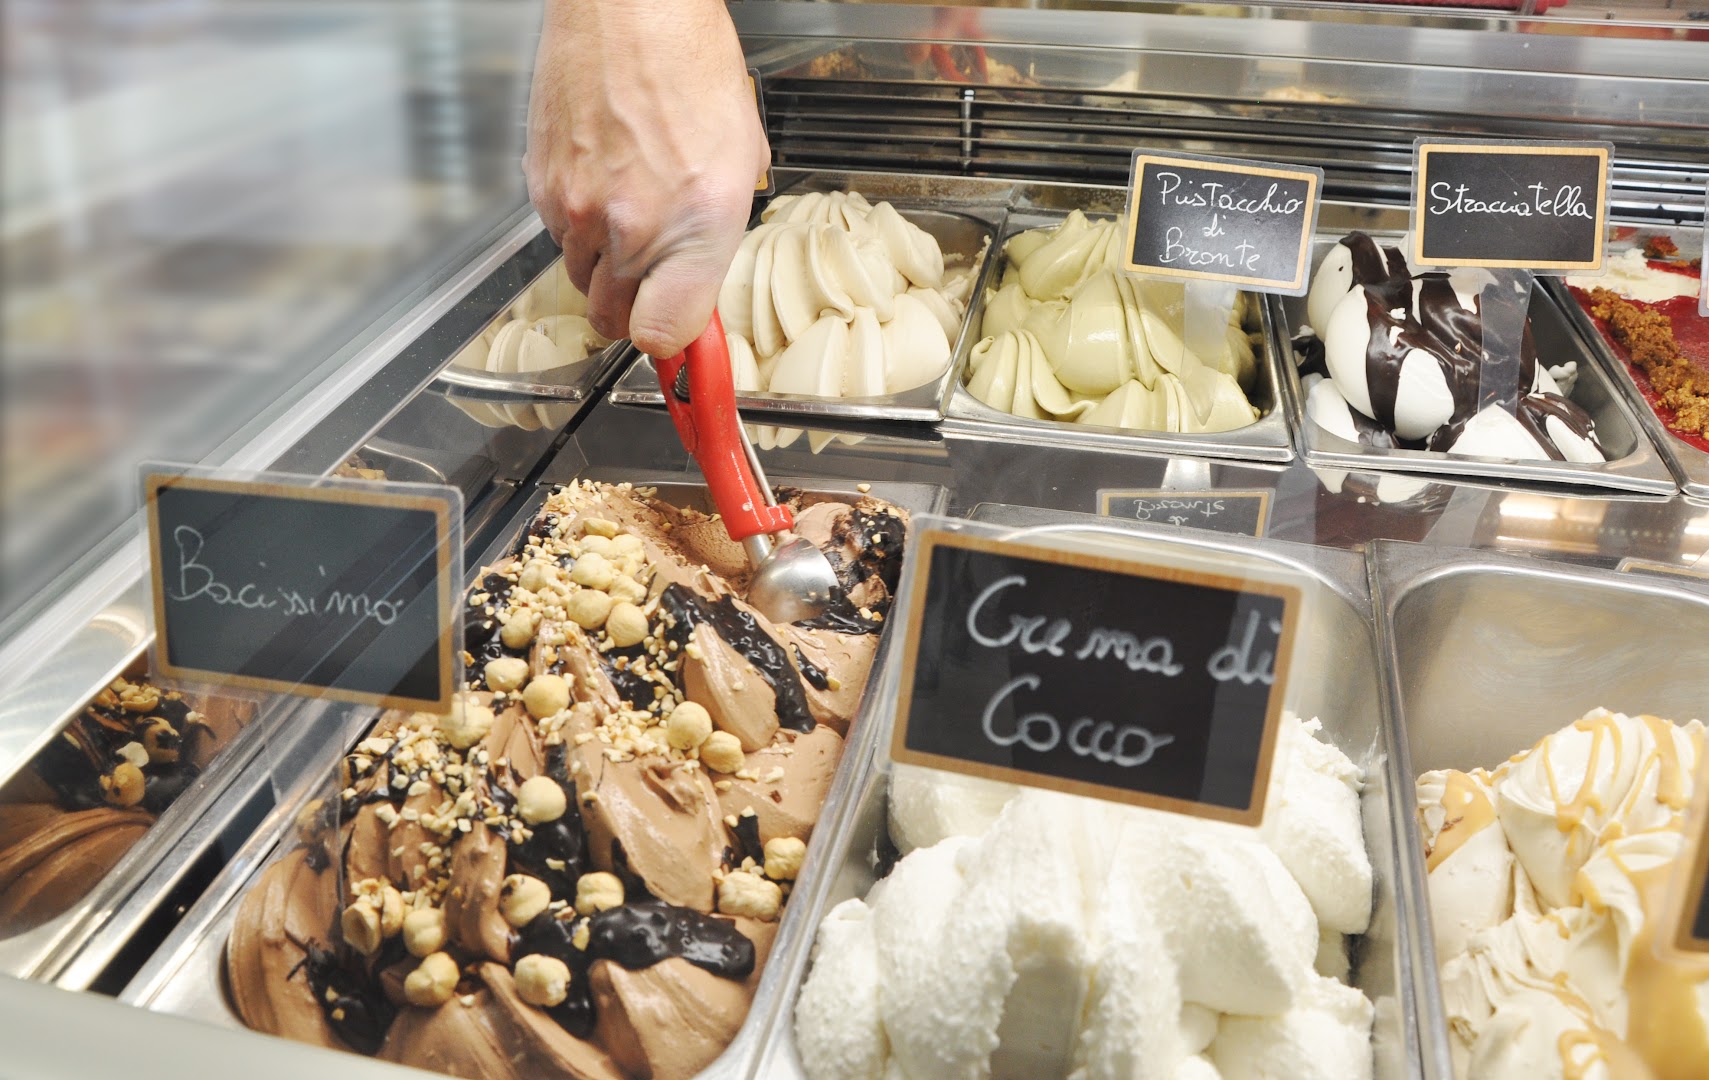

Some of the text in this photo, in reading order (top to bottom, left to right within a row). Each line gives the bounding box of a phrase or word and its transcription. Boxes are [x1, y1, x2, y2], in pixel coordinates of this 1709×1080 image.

[1202, 213, 1227, 237] di
[1430, 181, 1593, 219] Stracciatella
[1159, 226, 1261, 271] Bronte
[168, 525, 405, 625] Bacissimo
[966, 575, 1283, 684] Crema di
[982, 673, 1176, 767] Cocco
